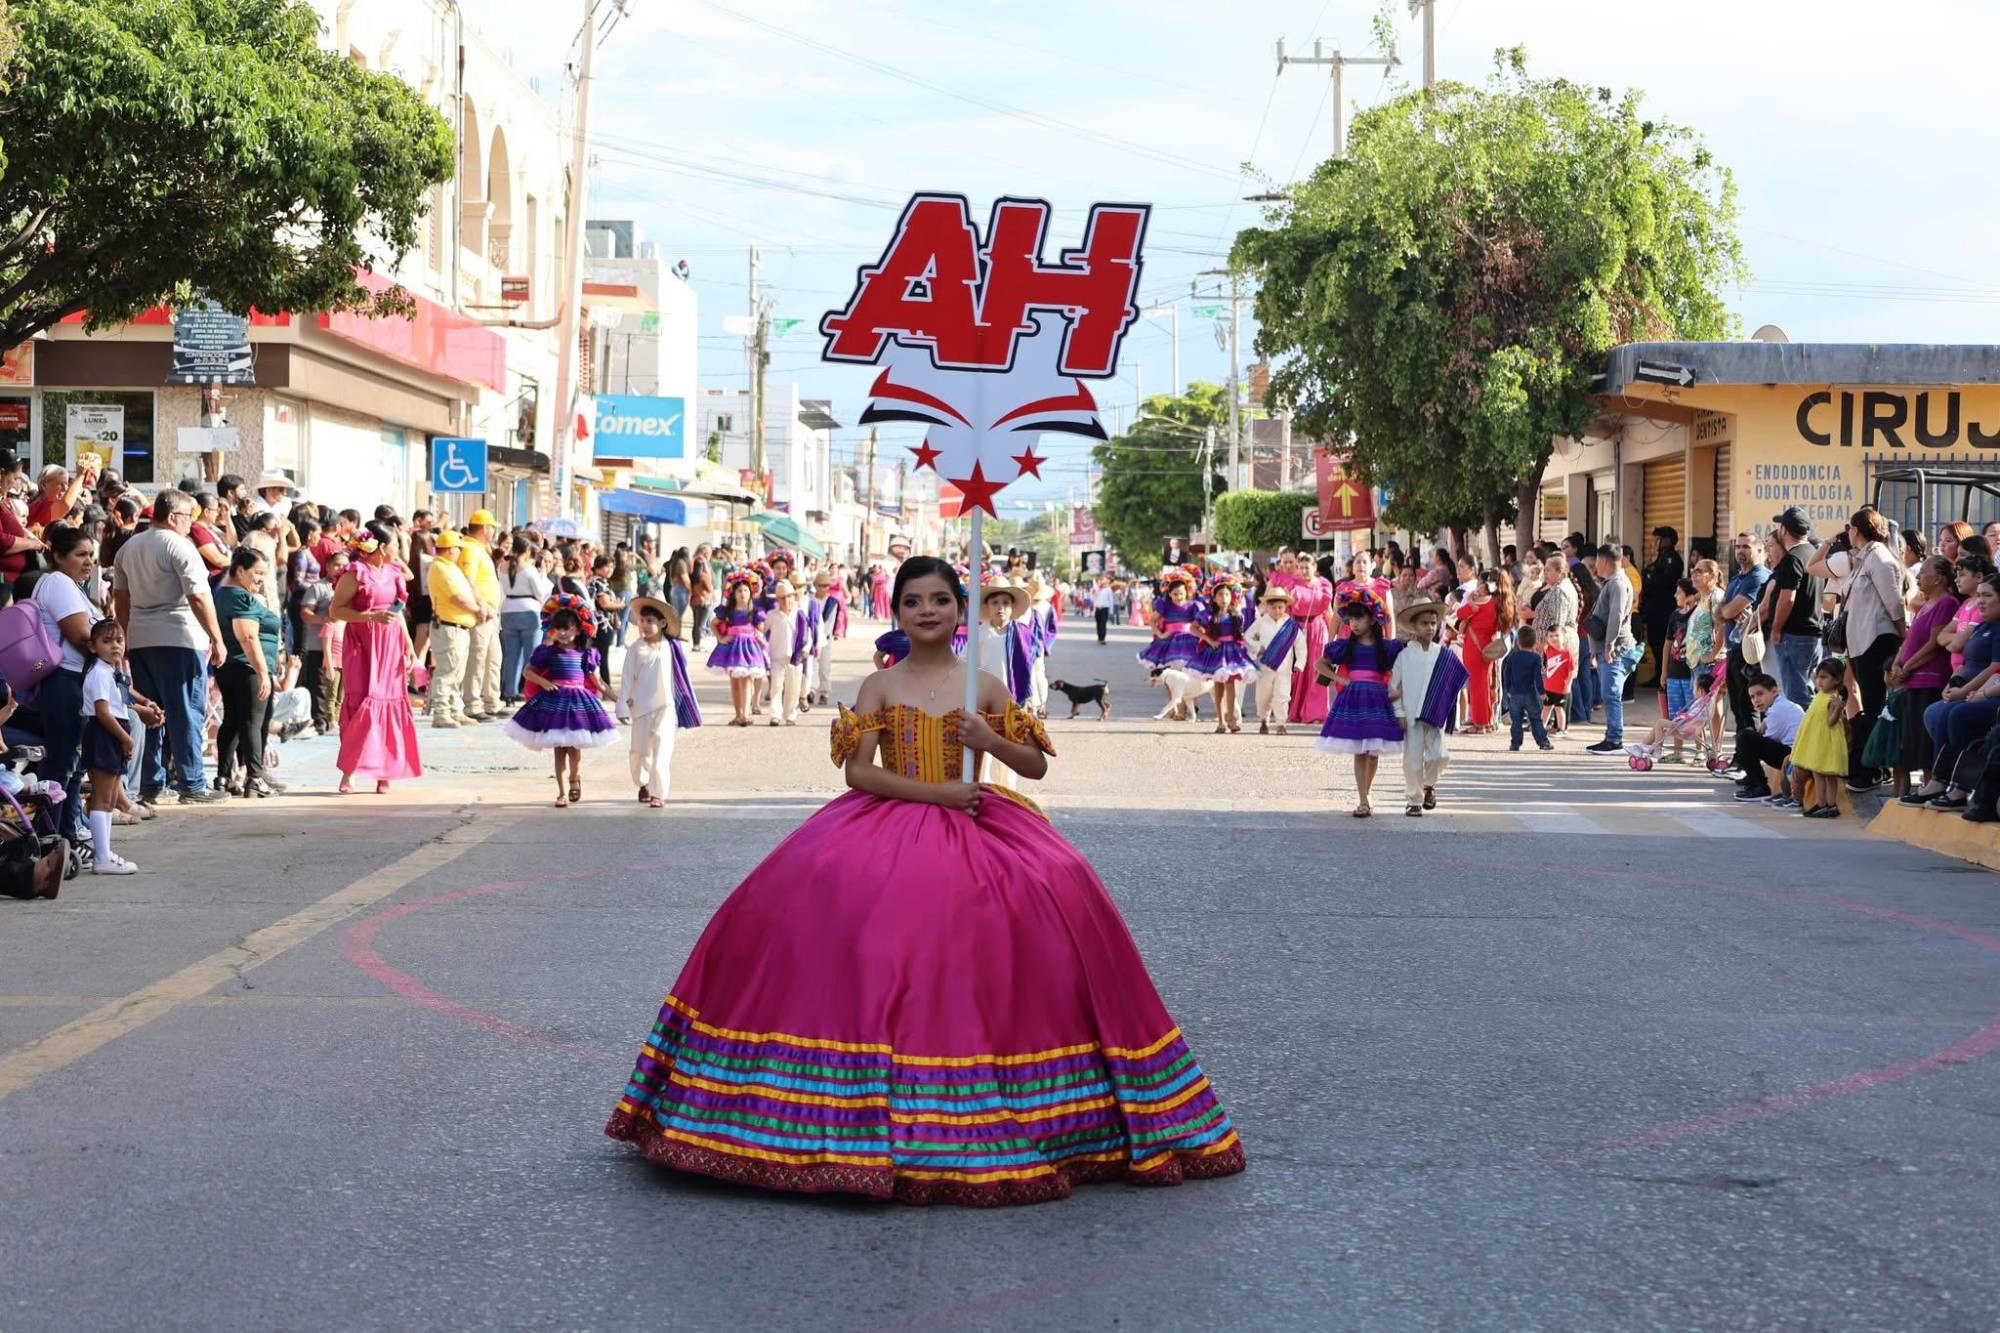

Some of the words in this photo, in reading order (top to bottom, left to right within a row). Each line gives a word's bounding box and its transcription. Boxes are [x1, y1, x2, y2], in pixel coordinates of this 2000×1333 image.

[819, 191, 1152, 380] AH
[97, 431, 118, 442] $20
[1696, 417, 1727, 440] DENTISTA
[1755, 464, 1841, 480] ENDODONCIA
[1755, 484, 1853, 500] ODONTOLOGIA
[1783, 504, 1851, 520] IEGRAL
